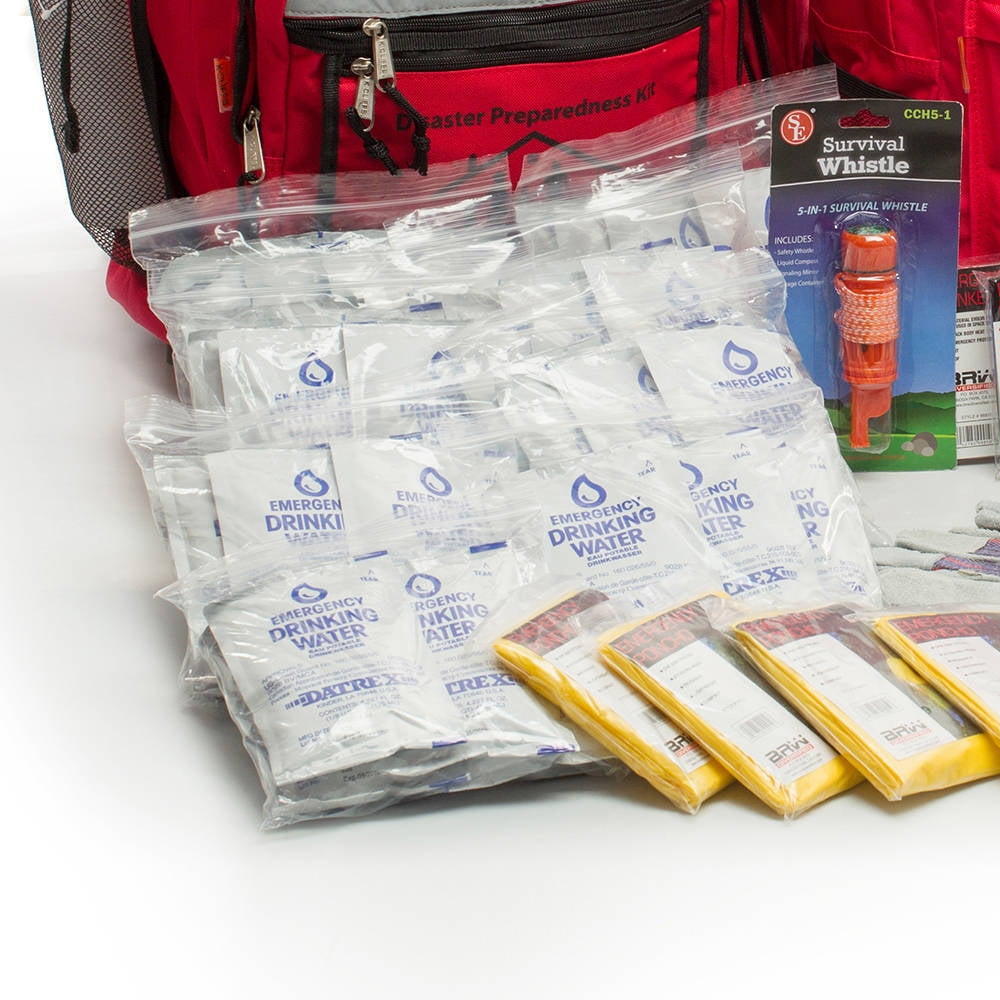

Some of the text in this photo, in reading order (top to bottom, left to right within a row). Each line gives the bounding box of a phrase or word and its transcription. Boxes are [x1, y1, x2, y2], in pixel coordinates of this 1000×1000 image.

[396, 82, 656, 131] Daster Preparedness Kit
[904, 109, 951, 120] CCH5-1
[823, 136, 905, 153] Survival
[817, 155, 910, 176] Whistle
[797, 201, 928, 216] 5-IN-1 SURVIVAL WHISTLE
[550, 496, 641, 525] EMERGENCY
[548, 507, 656, 546] DRINKING
[570, 528, 646, 558] WATER
[605, 545, 639, 557] POTABLE
[268, 607, 378, 643] DRINKING
[271, 596, 364, 626] EMERGENCY
[290, 623, 368, 650] WATER
[765, 733, 811, 764] BRW
